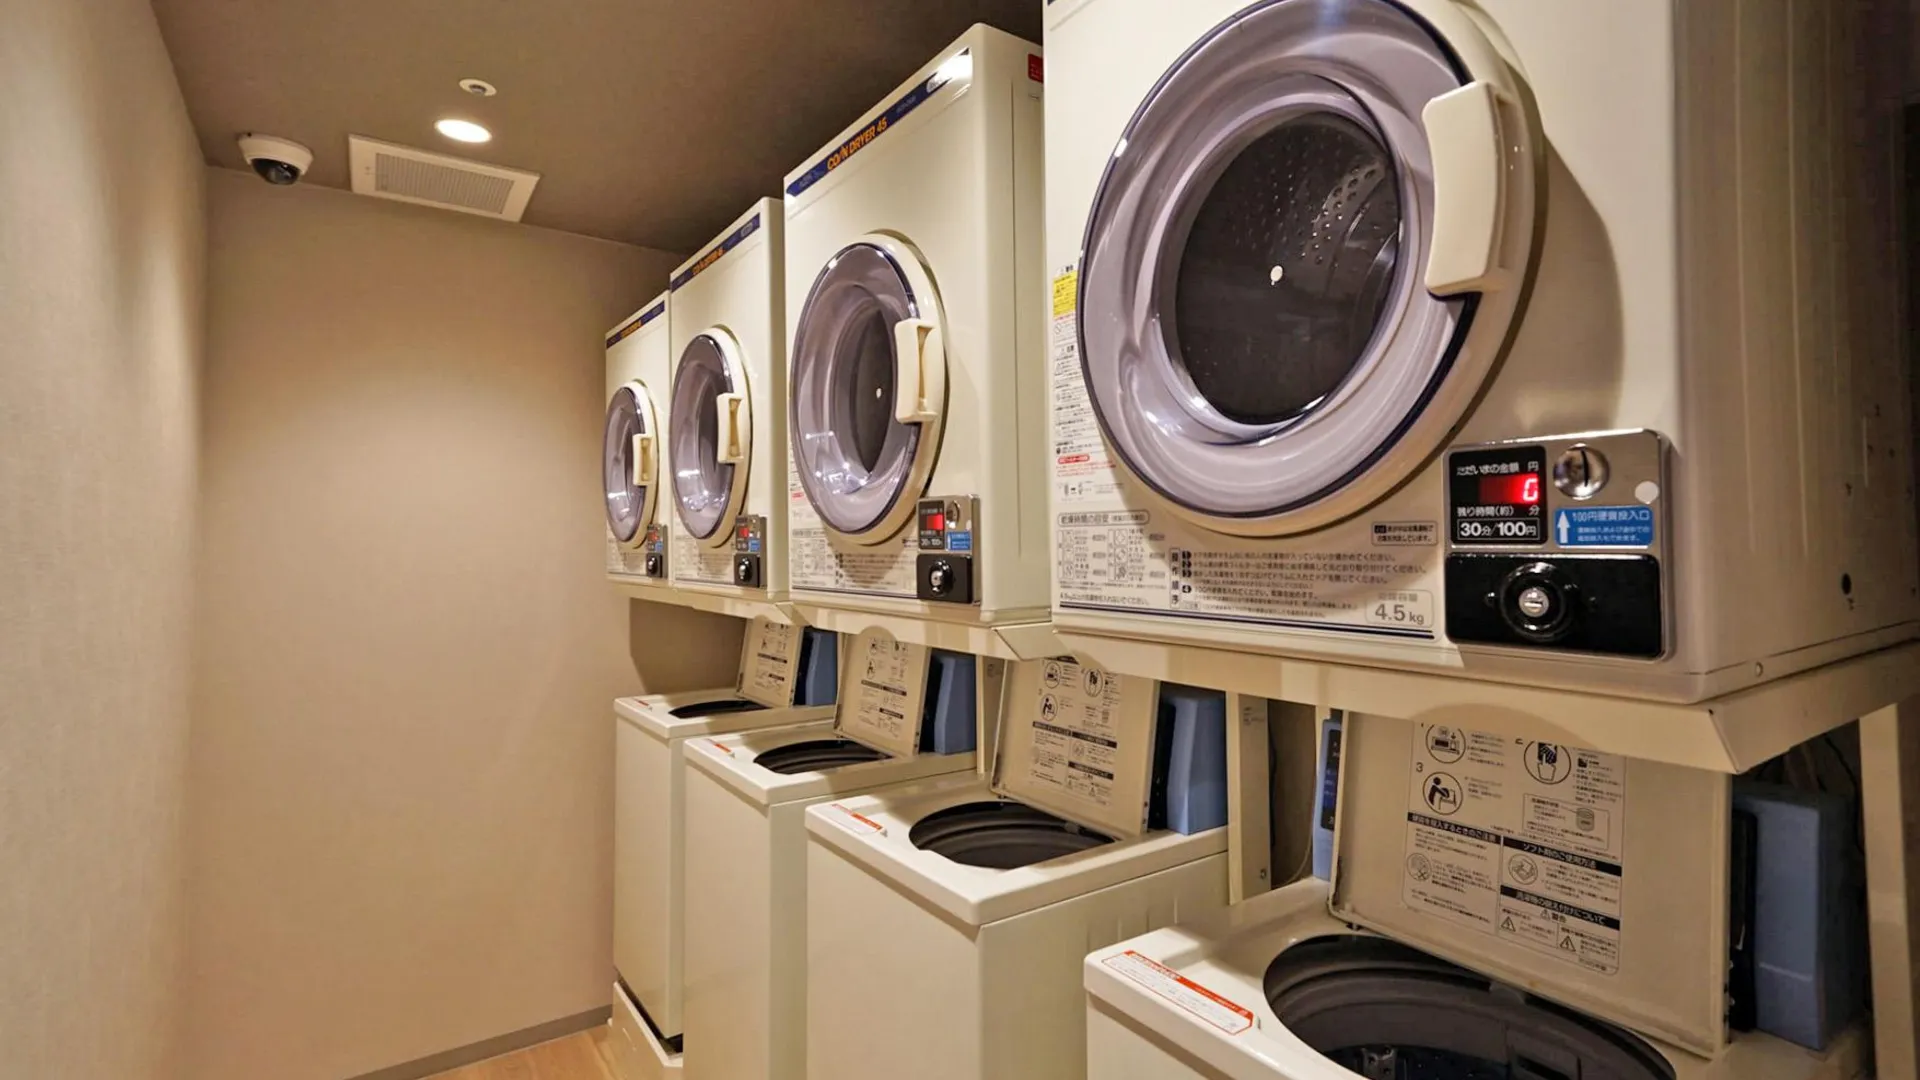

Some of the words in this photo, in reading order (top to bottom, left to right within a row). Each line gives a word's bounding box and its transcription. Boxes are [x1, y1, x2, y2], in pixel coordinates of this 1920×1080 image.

[849, 126, 875, 153] DRYER
[876, 116, 888, 132] 45
[1528, 461, 1539, 471] 円
[1529, 505, 1541, 516] 分
[1459, 522, 1537, 537] 30分/100円
[1375, 604, 1406, 621] 4.5
[1409, 611, 1425, 625] kg
[1416, 762, 1424, 773] 3
